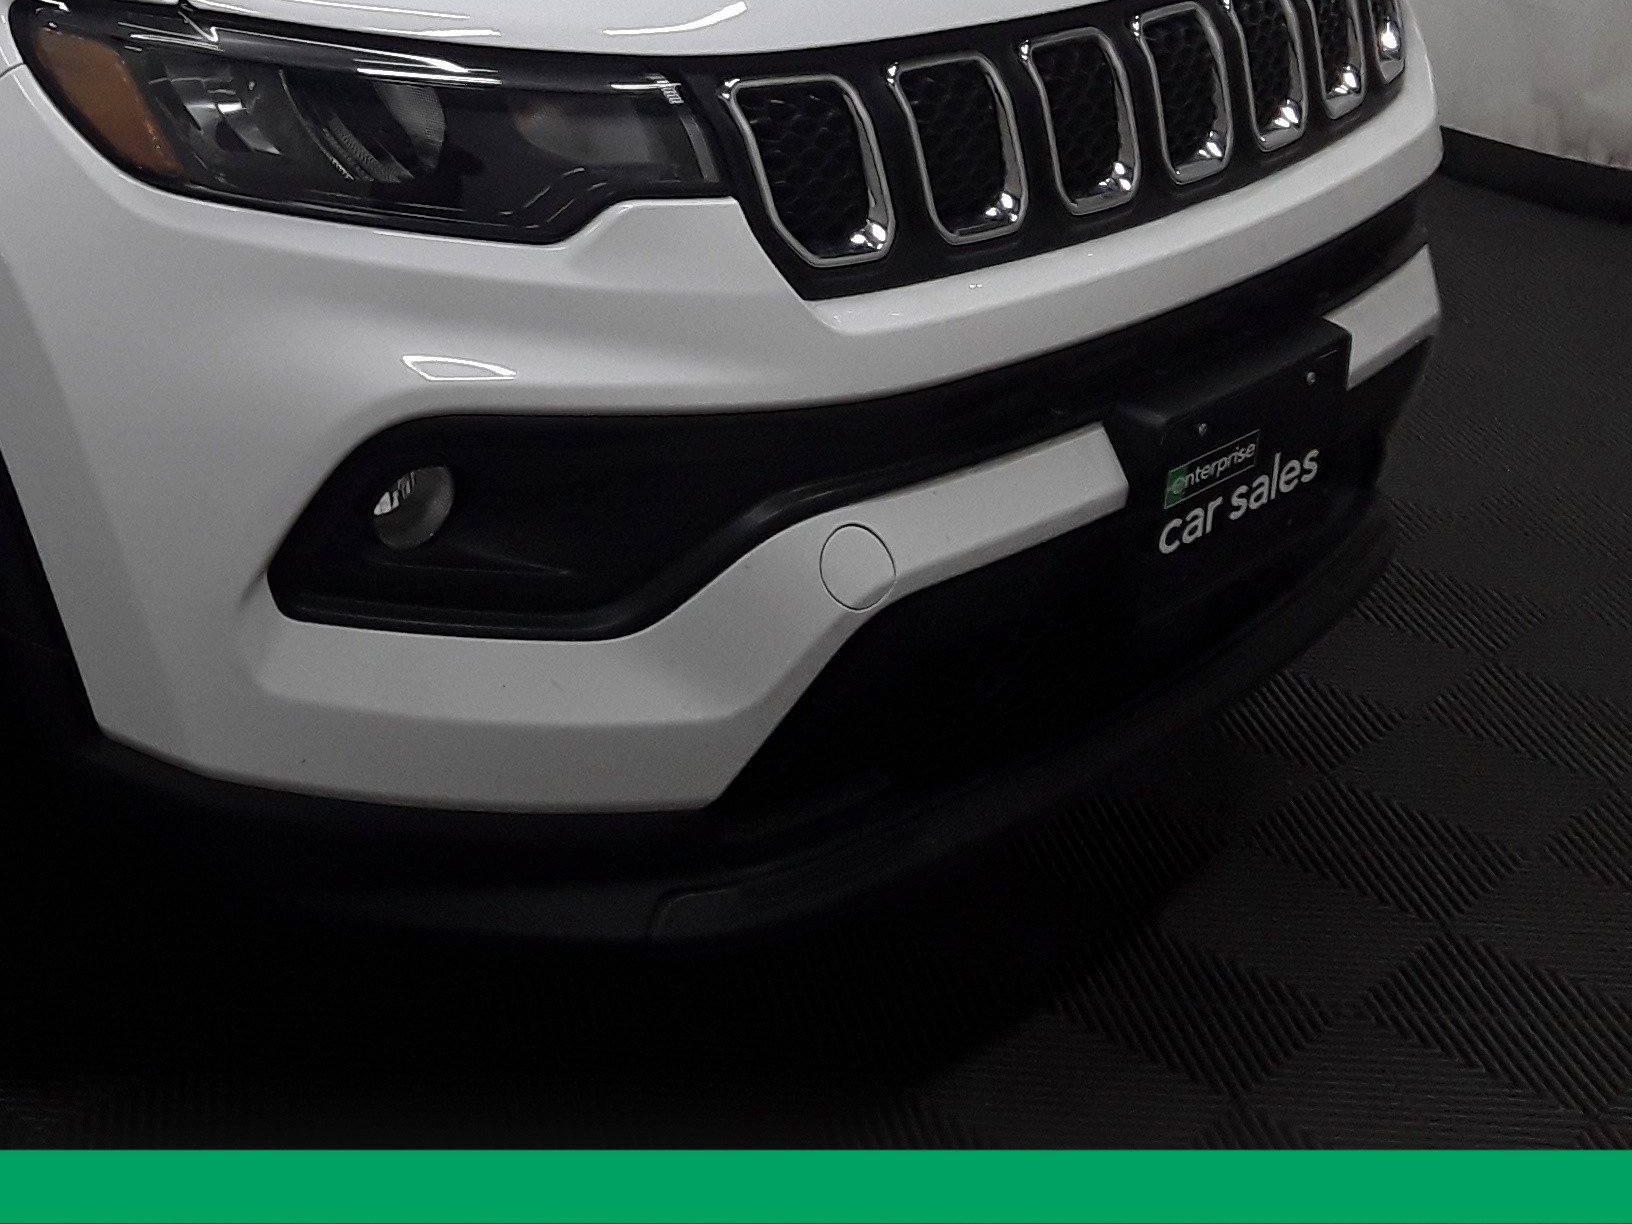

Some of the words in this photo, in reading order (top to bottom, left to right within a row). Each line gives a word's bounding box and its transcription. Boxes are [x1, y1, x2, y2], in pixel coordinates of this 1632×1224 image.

[1159, 496, 1223, 554] car
[1229, 449, 1319, 520] sales
[1172, 443, 1255, 495] enterprise
